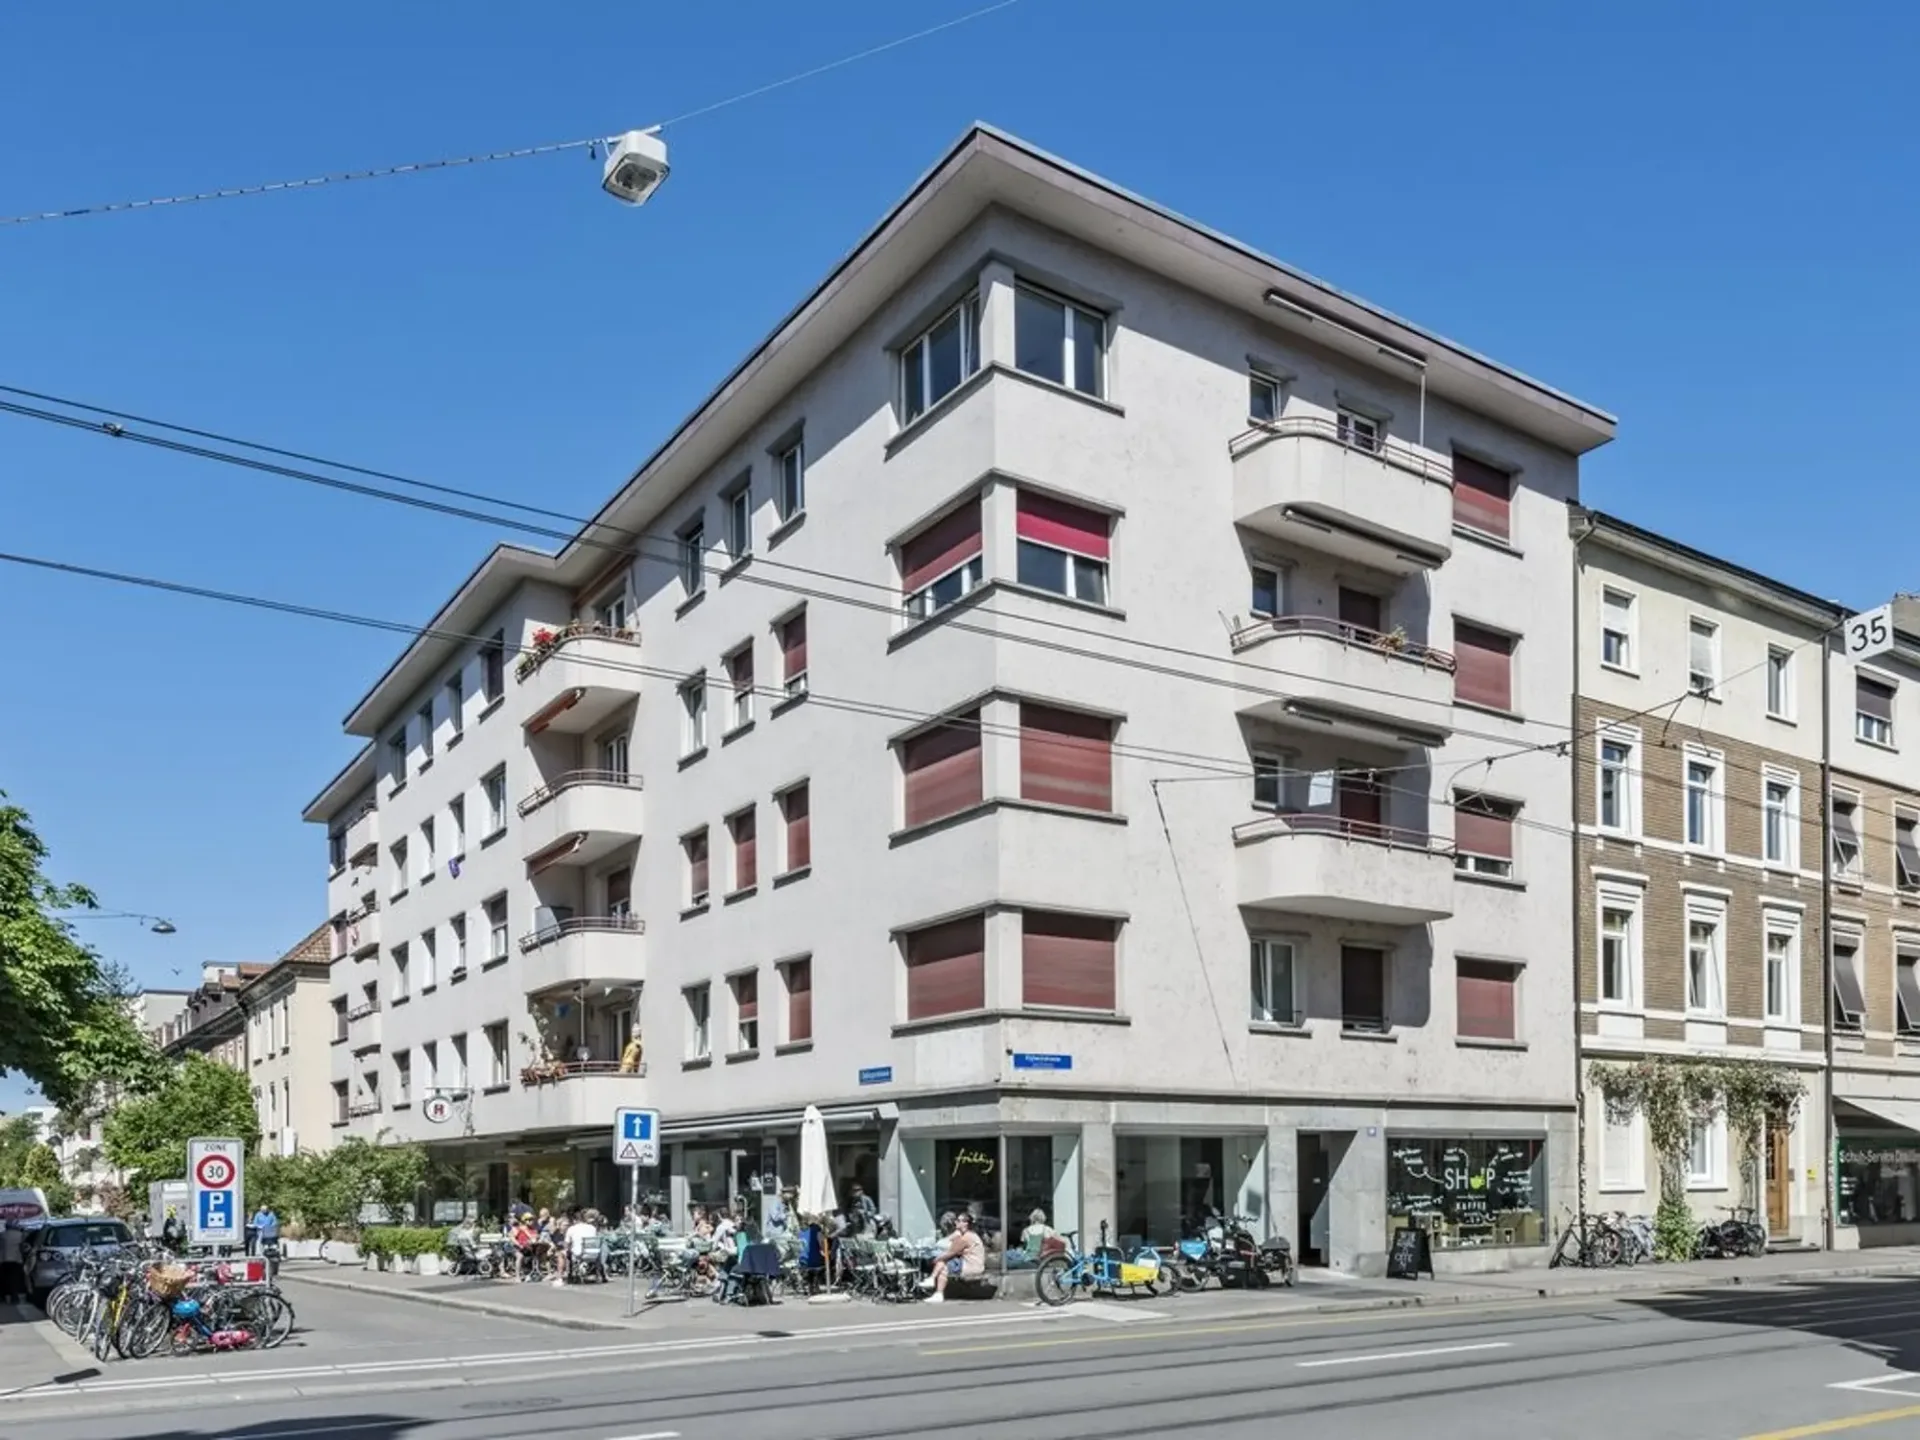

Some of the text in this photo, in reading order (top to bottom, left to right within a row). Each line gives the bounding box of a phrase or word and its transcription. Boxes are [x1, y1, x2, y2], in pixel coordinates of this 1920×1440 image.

[1851, 614, 1887, 652] 35
[204, 1143, 227, 1152] ZONE
[207, 1165, 225, 1179] 30
[209, 1191, 225, 1212] P
